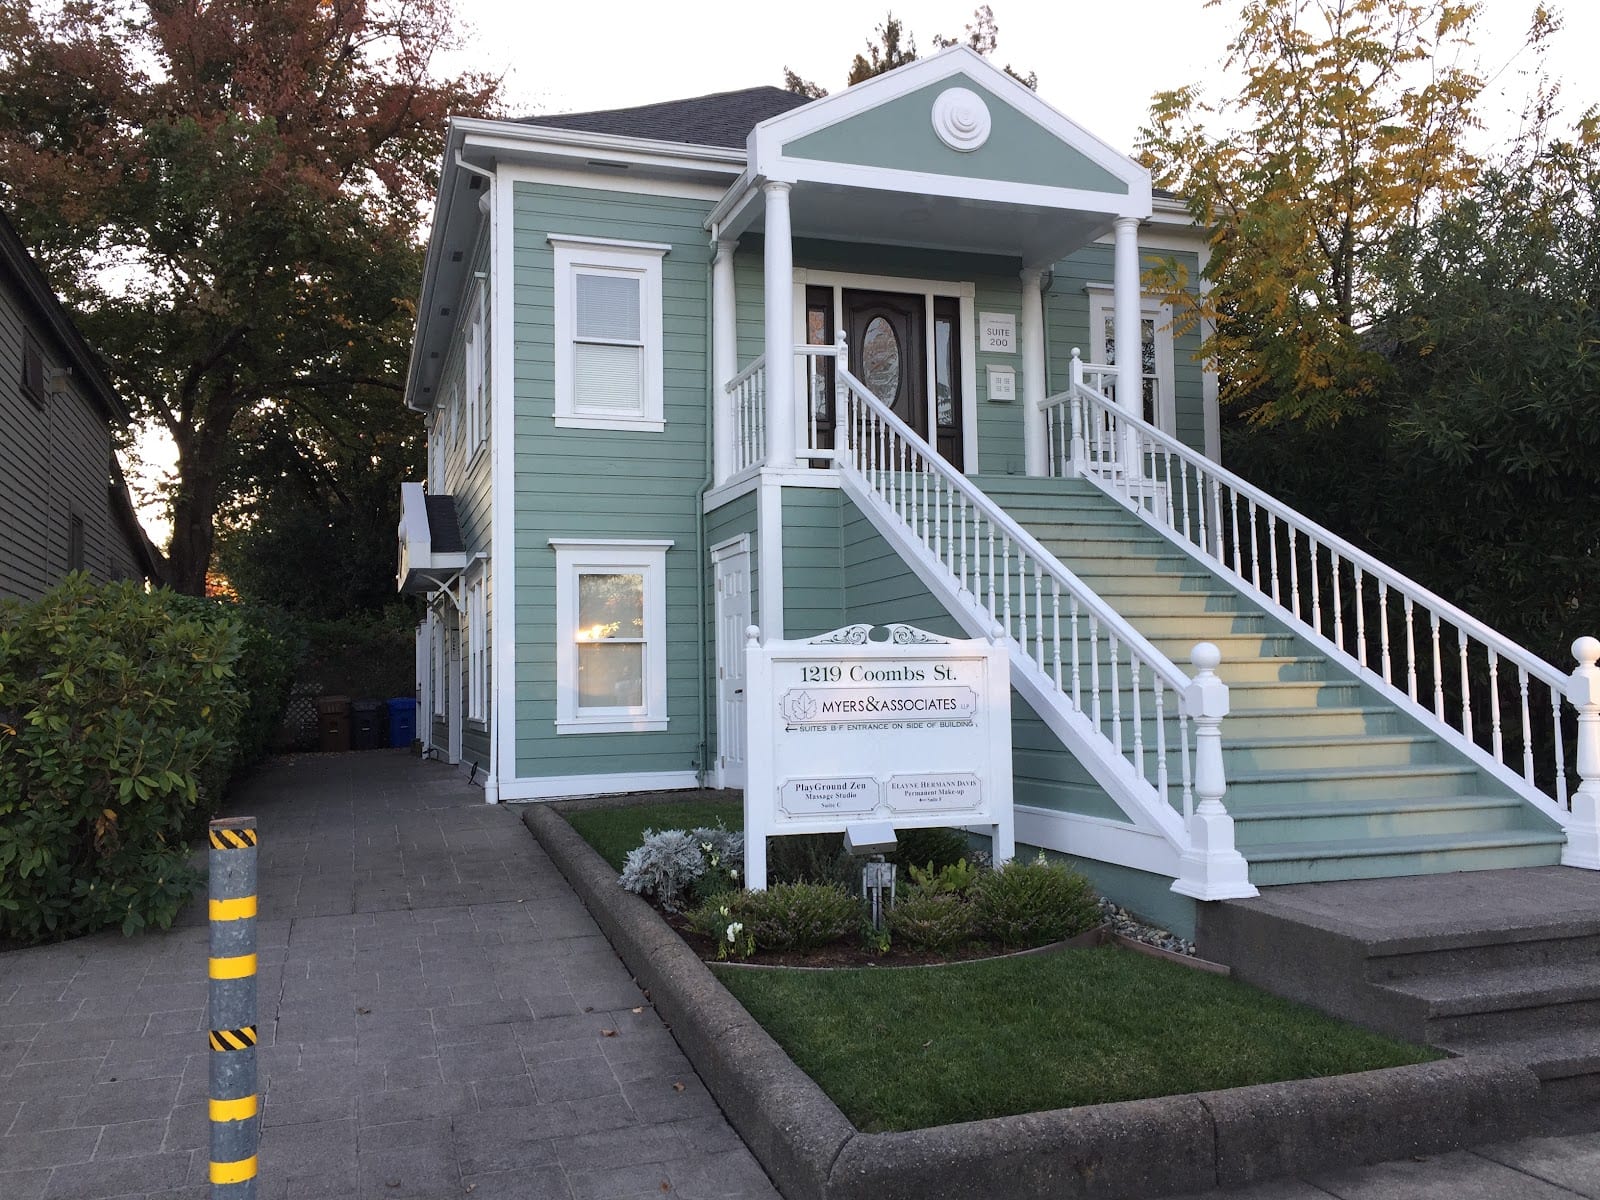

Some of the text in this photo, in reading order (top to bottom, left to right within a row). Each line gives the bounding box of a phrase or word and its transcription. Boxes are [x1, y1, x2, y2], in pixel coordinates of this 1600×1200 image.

[986, 327, 1010, 337] SUITE
[990, 338, 1008, 347] 200
[801, 663, 957, 682] 1219 Coombs St.
[822, 696, 957, 713] MYERS&ASSOCIATES
[799, 725, 827, 733] SUITES
[847, 723, 889, 731] ENTRANCE
[795, 781, 866, 792] PlayGround Zen
[891, 782, 918, 790] ELAYNE
[920, 780, 955, 788] HERMANN
[805, 791, 857, 801] Massage Studio
[904, 788, 965, 797] Permanent Make-up
